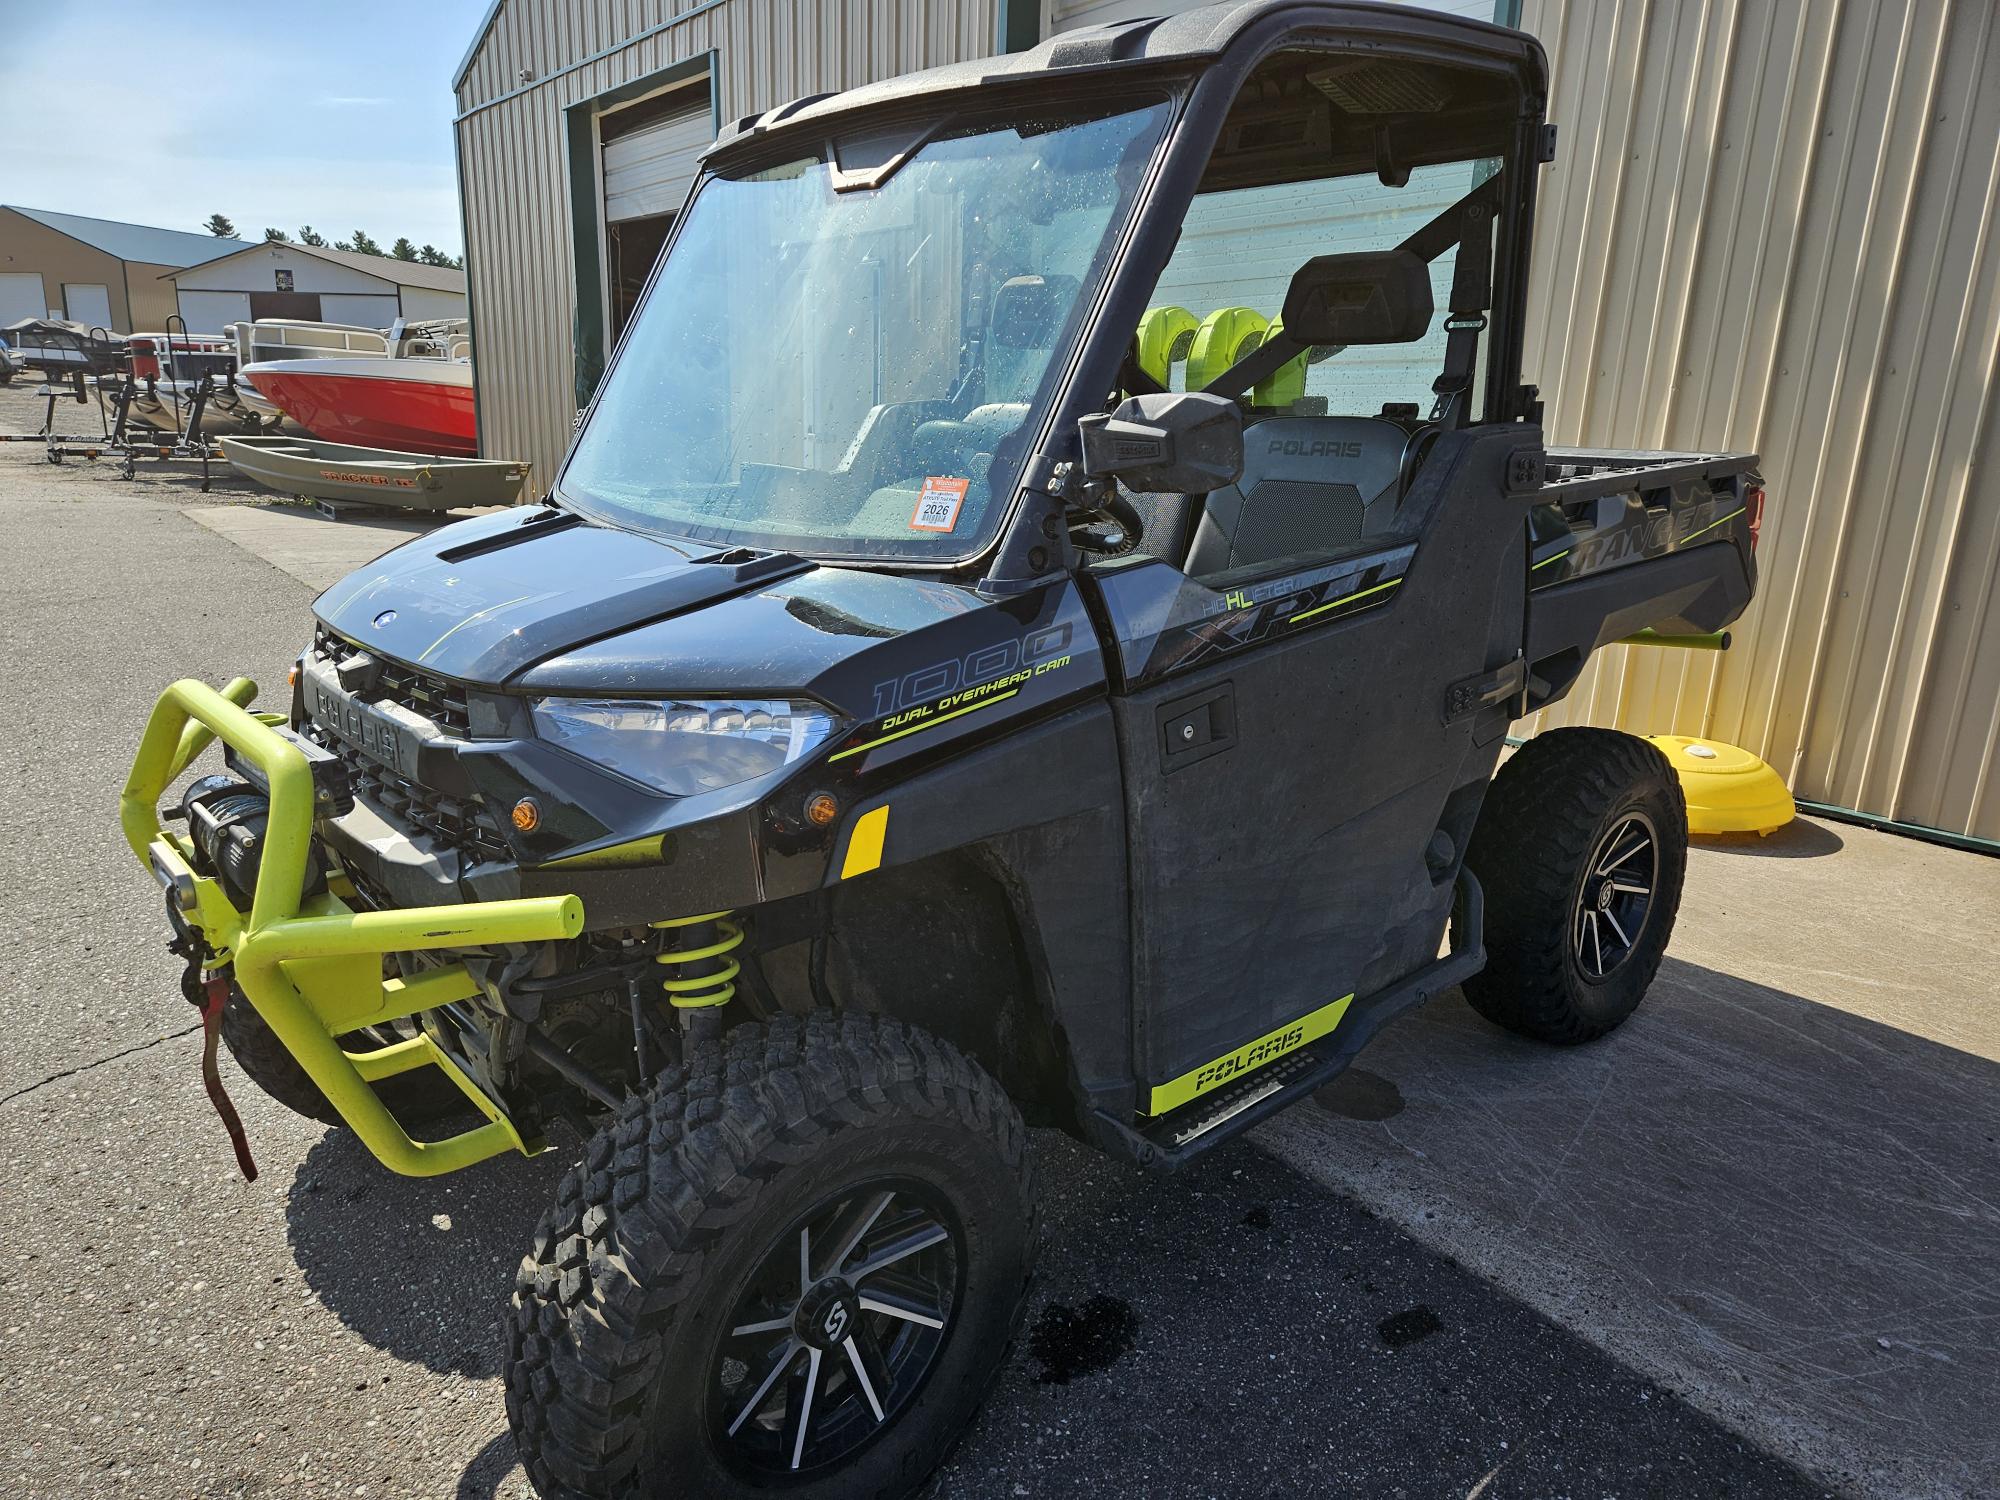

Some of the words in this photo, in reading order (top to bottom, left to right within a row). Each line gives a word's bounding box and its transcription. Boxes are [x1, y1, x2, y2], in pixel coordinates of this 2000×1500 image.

[320, 471, 389, 485] TRACKER
[1267, 440, 1362, 458] POLARIS
[923, 504, 950, 516] 2026
[1571, 501, 1713, 576] RANGER
[873, 621, 1074, 718] 1000
[882, 705, 933, 731] DUAL
[938, 668, 1032, 711] OVERHEAD
[1035, 655, 1071, 676] CAM
[1195, 1026, 1304, 1091] POLARIS
